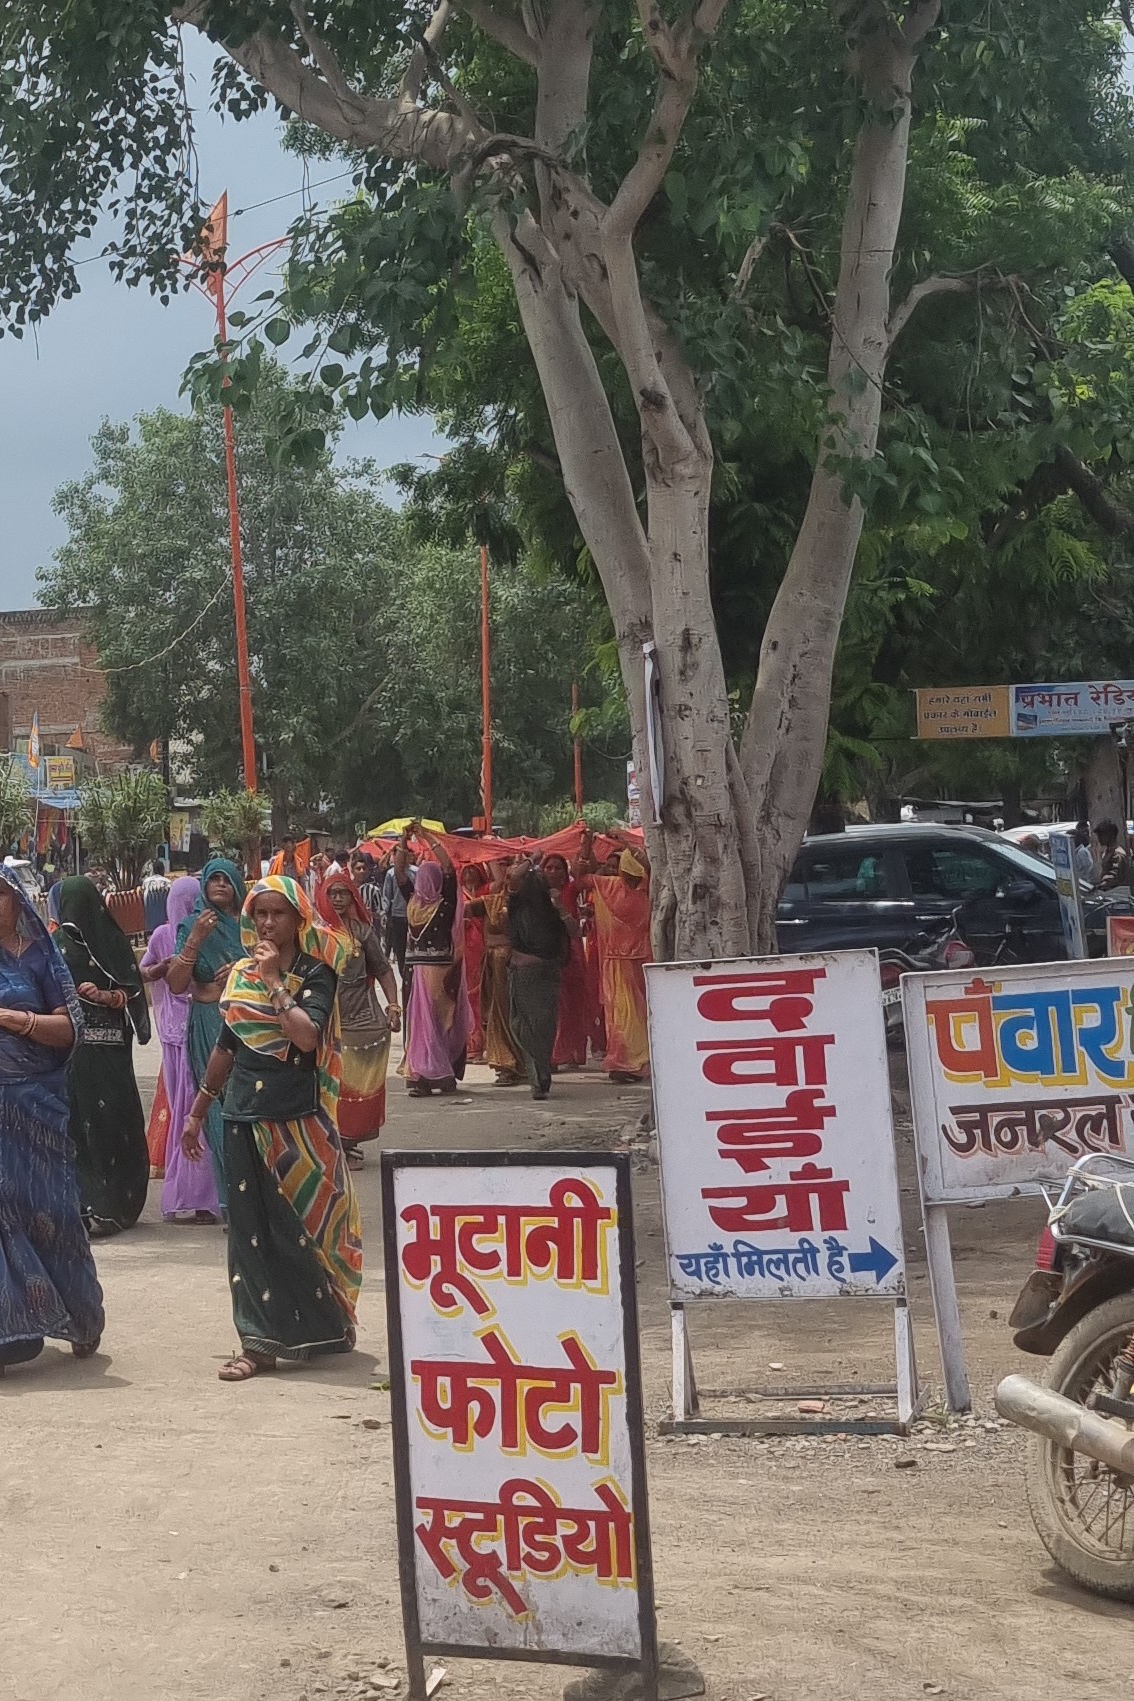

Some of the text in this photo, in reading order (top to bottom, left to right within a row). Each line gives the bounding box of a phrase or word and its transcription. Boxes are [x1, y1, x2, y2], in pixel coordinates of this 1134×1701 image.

[1020, 692, 1080, 709] प्रभात
[941, 1095, 1123, 1154] जनरल
[400, 1177, 612, 1315] भूटानी
[732, 1237, 820, 1282] मिलती
[826, 1235, 849, 1284] है
[410, 1330, 617, 1455] फोटो
[414, 1478, 633, 1616] स्टूडियो
